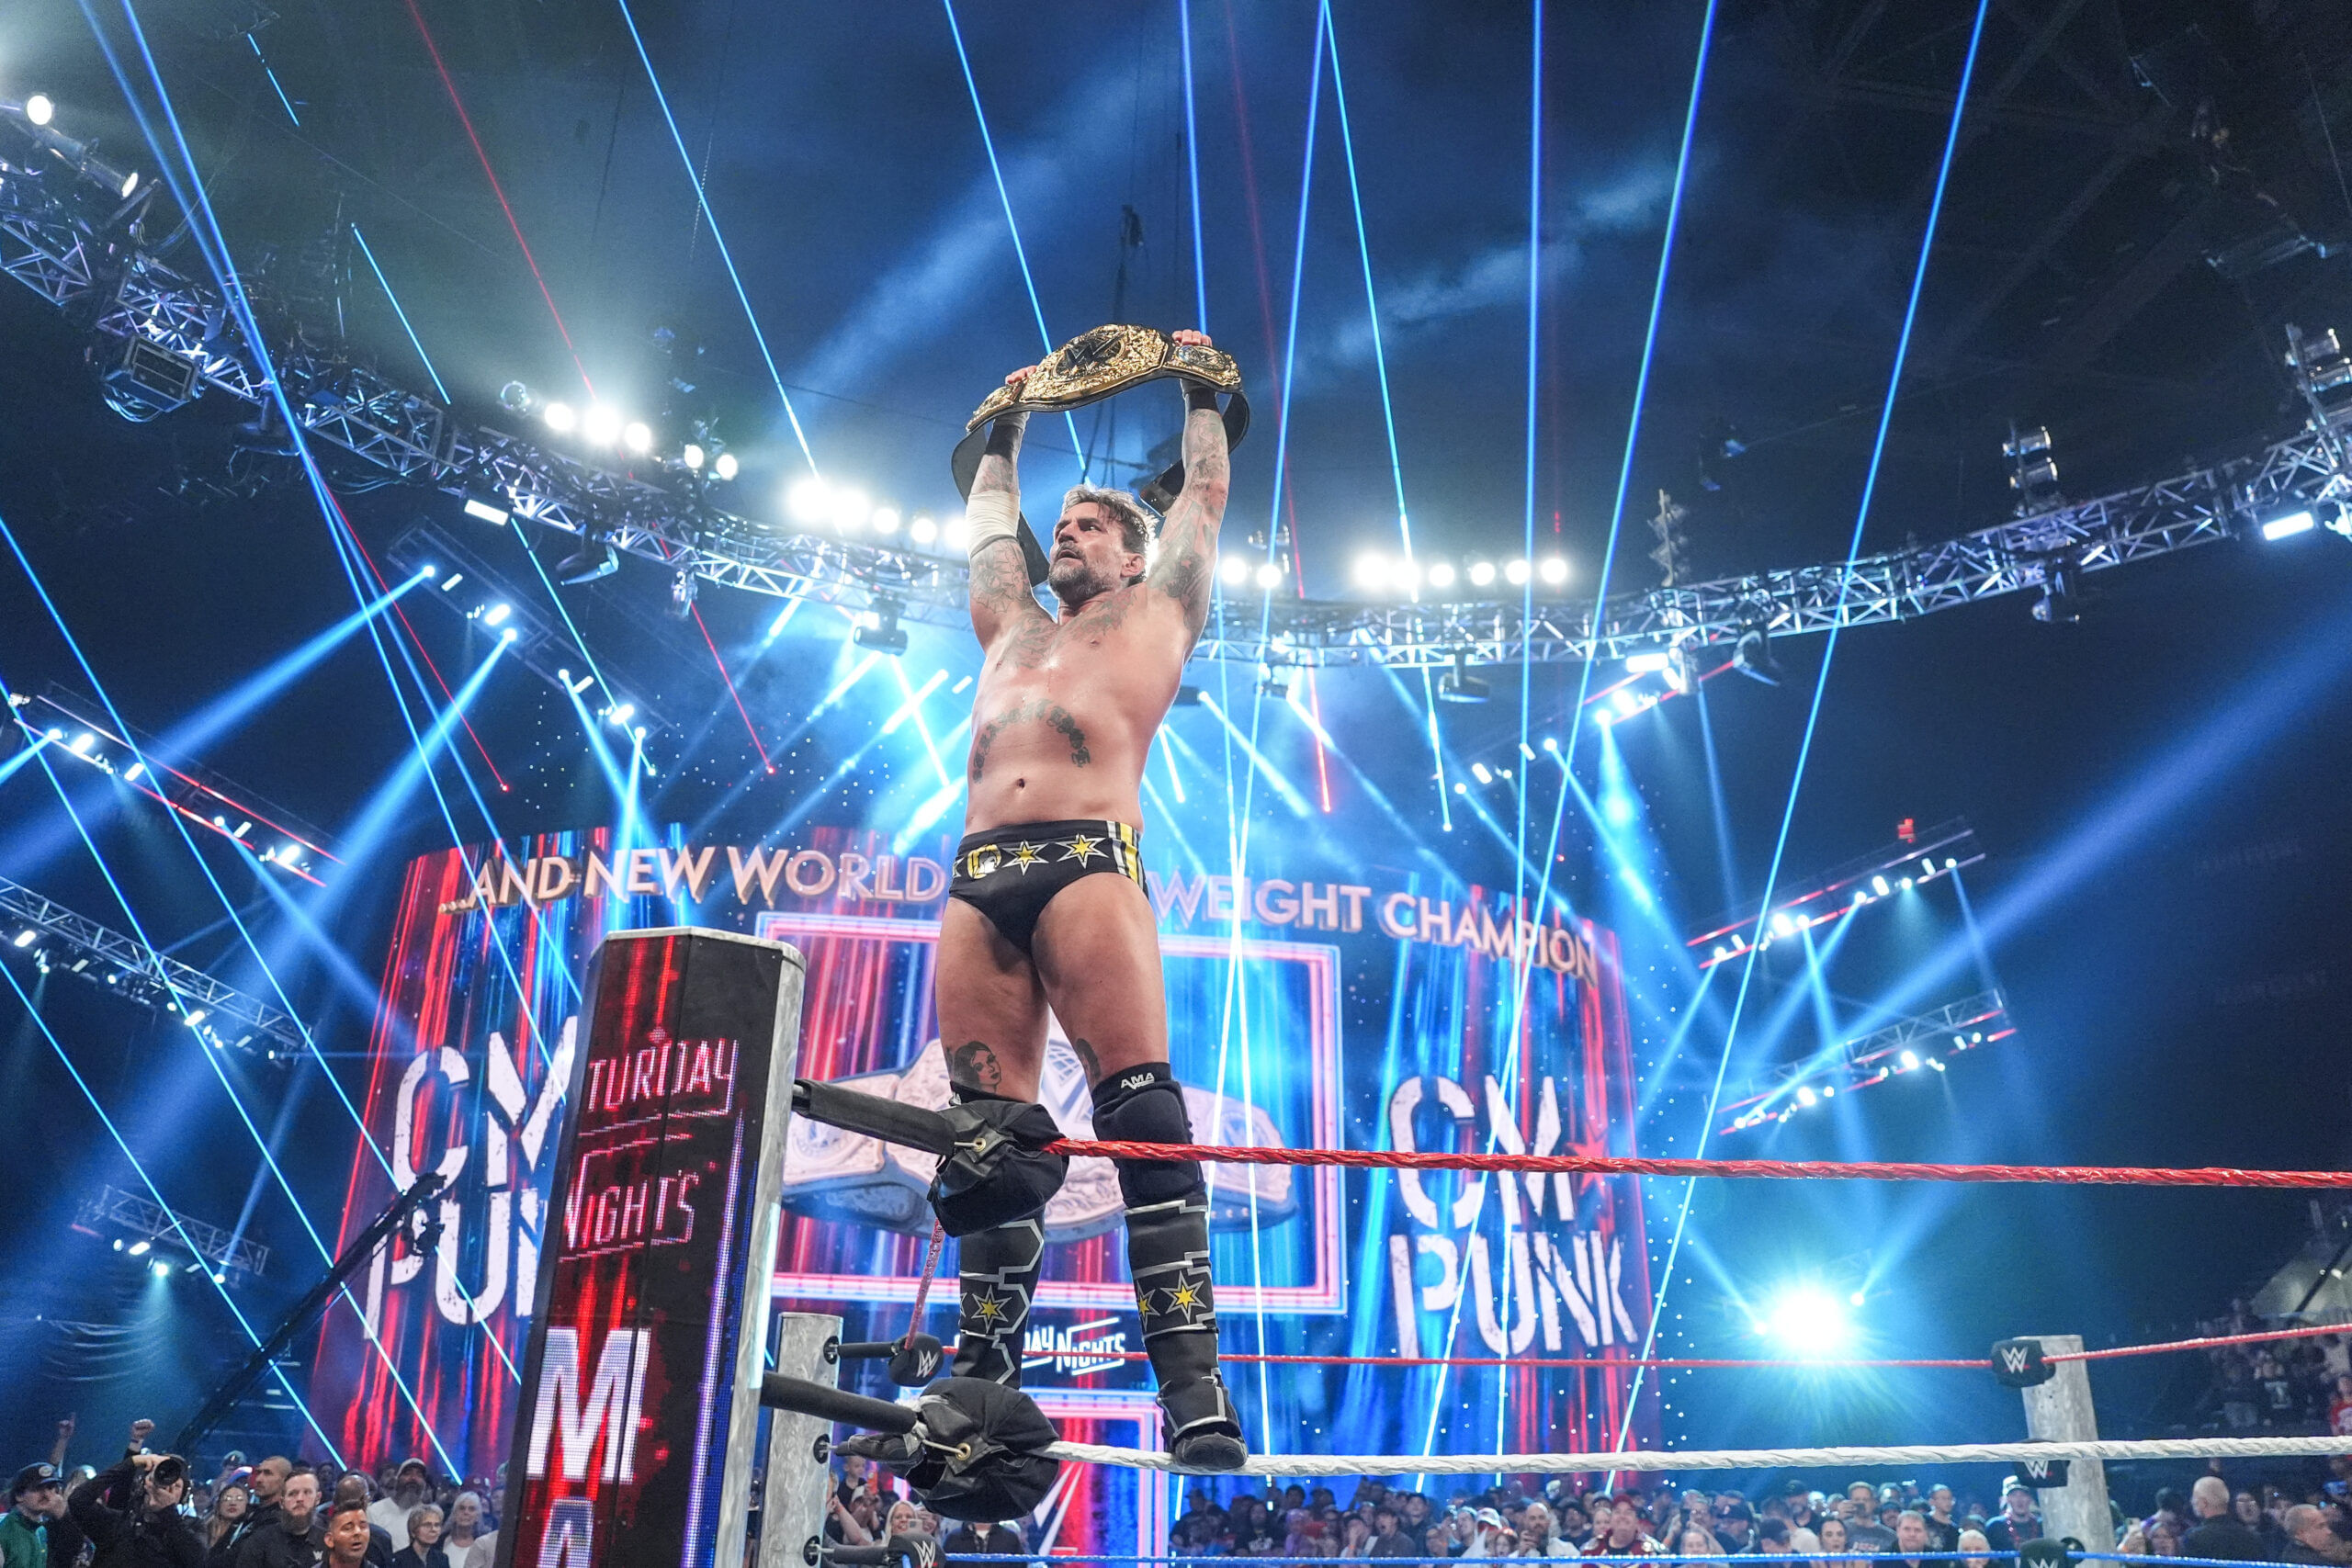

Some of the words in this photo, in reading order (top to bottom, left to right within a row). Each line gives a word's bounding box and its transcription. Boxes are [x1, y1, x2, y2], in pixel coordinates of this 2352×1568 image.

[583, 846, 715, 904] NEW
[727, 844, 946, 908] WORLD
[1384, 892, 1599, 987] CHAMPION
[1389, 1075, 1575, 1229] CM
[1388, 1230, 1638, 1359] PUNK
